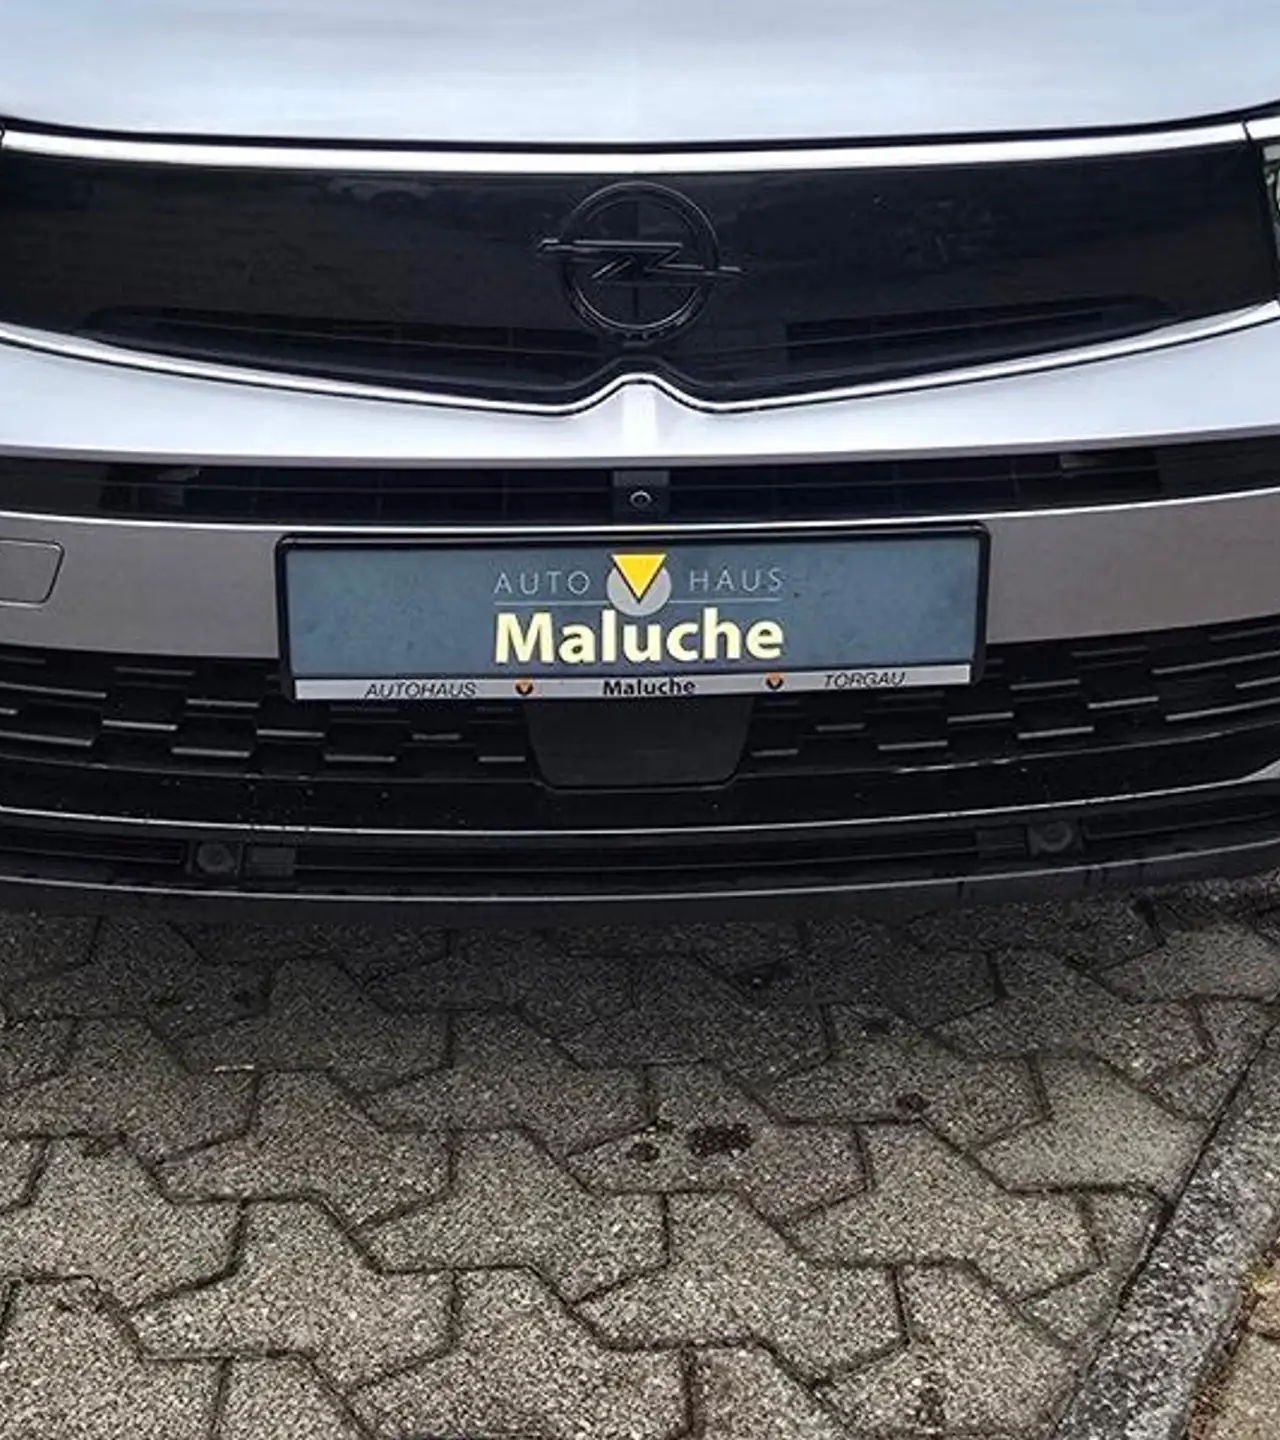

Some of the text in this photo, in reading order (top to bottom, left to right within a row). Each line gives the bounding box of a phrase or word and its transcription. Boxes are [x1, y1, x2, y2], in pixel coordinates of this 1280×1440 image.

[493, 566, 785, 595] AUTO HAUS
[494, 606, 785, 665] Maluche
[364, 671, 907, 700] AUTOHAUS Maluche TORGAU
